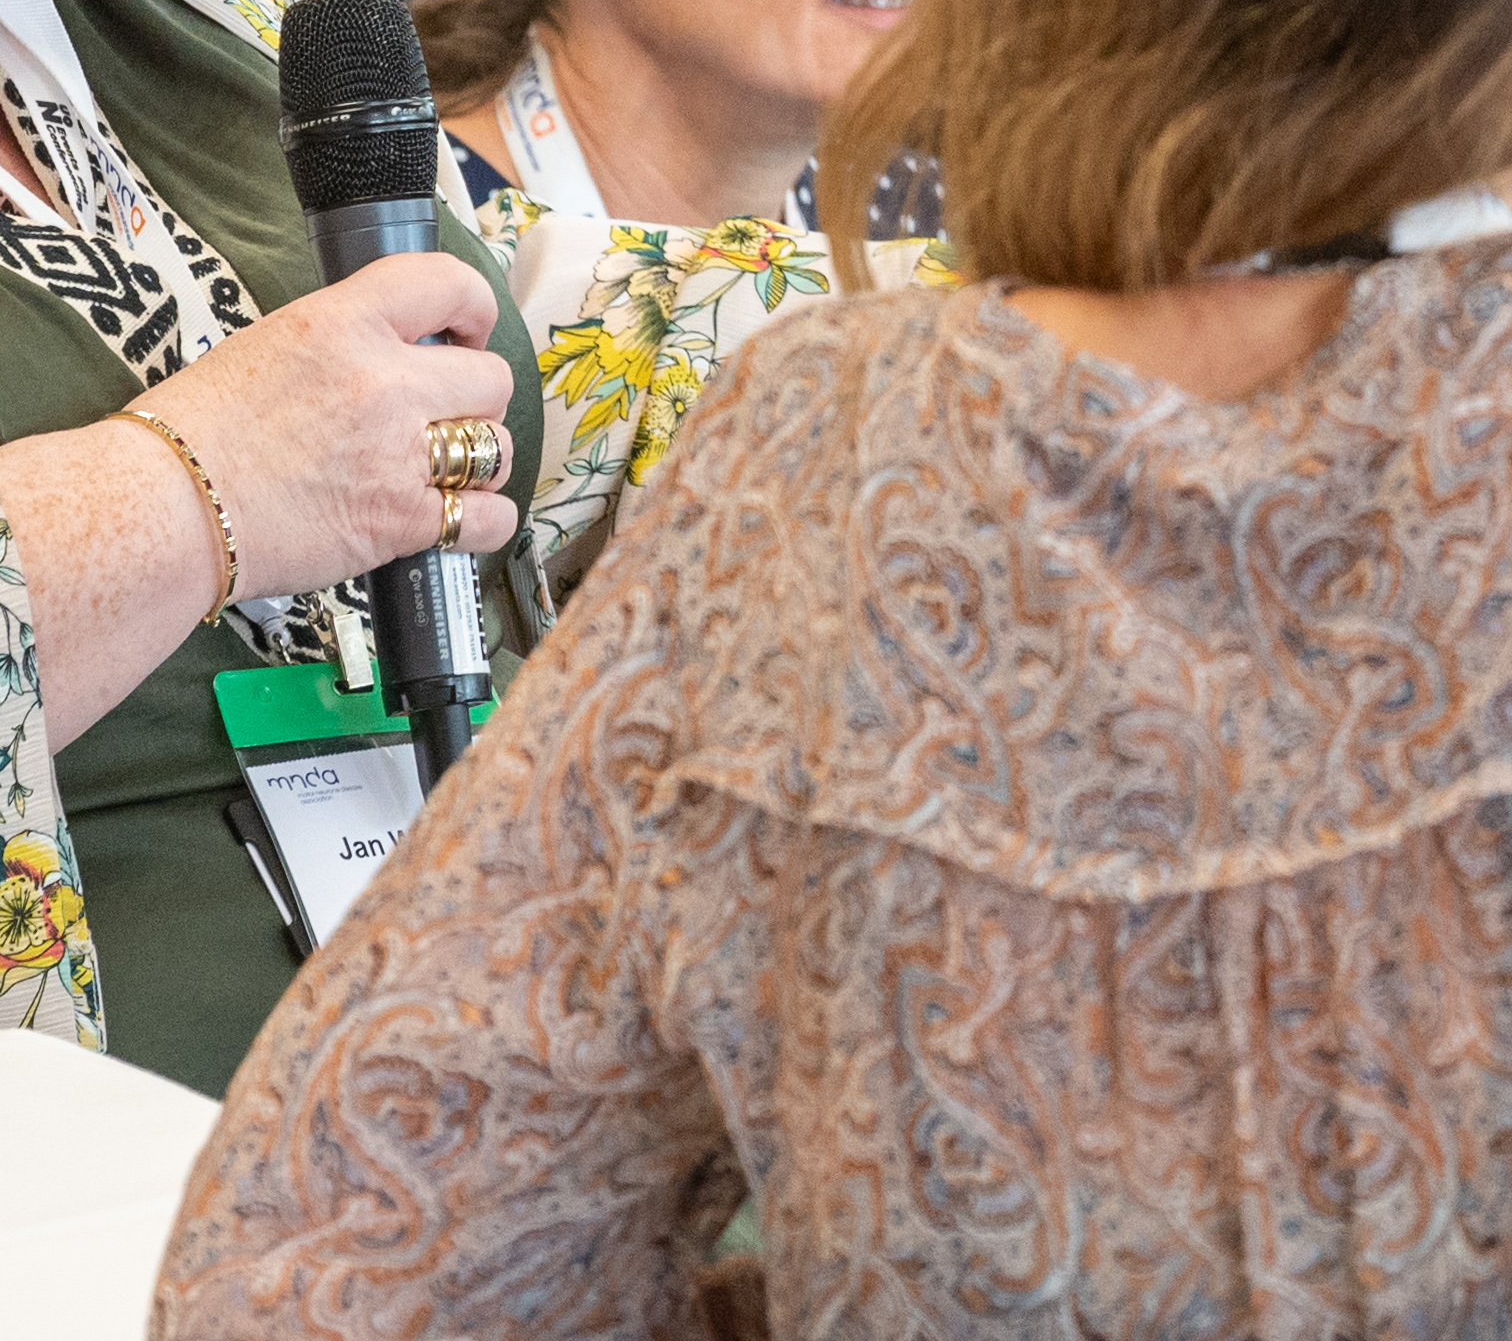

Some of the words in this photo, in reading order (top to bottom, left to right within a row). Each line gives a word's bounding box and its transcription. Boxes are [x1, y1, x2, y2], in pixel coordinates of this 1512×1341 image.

[45, 123, 84, 213] Conferencing
[56, 126, 80, 171] Events
[426, 555, 450, 661] SENNHEISER
[266, 766, 340, 791] mnda
[339, 836, 385, 860] Jan
